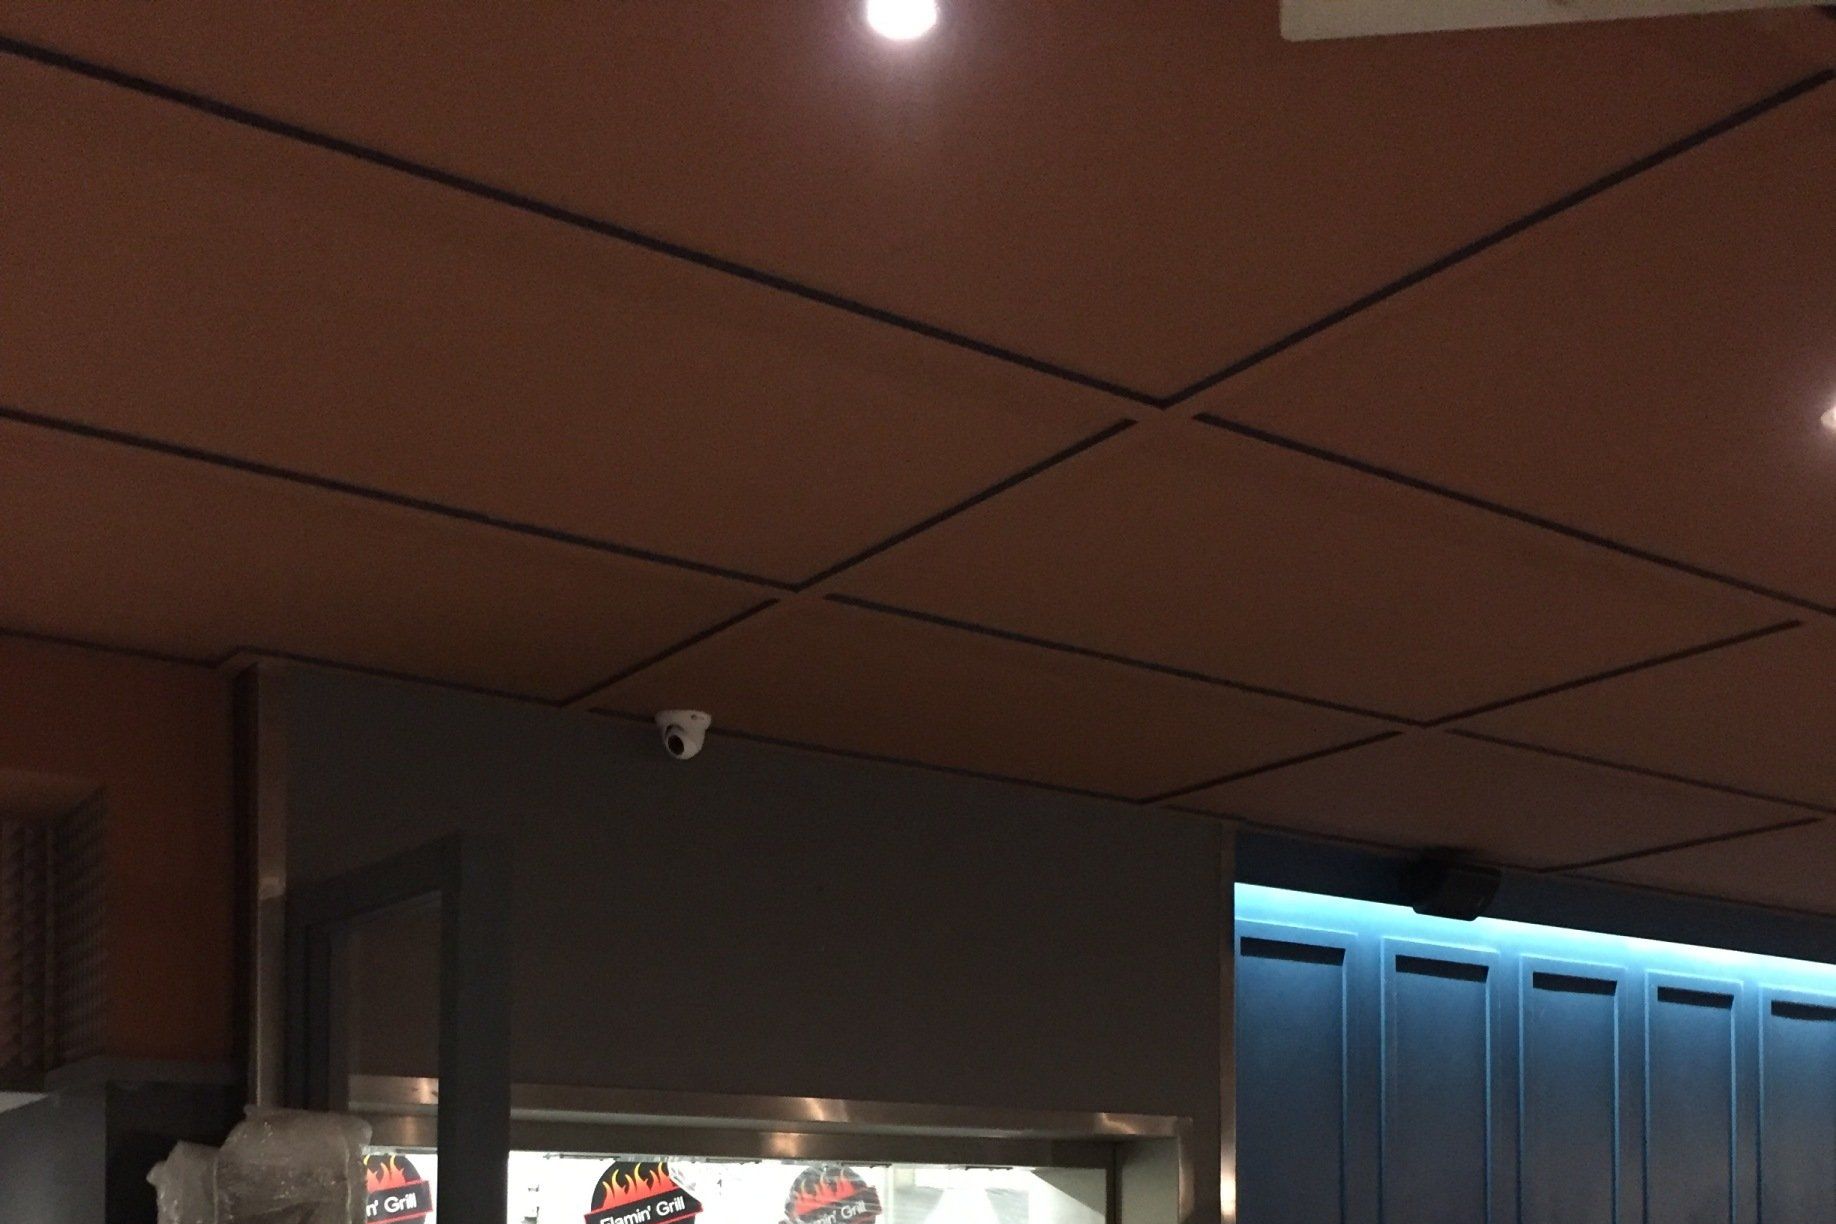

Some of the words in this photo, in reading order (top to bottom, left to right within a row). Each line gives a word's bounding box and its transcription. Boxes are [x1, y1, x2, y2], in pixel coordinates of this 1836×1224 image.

[384, 1192, 417, 1213] Grill
[656, 1195, 686, 1216] Grill
[841, 1200, 866, 1219] Grill
